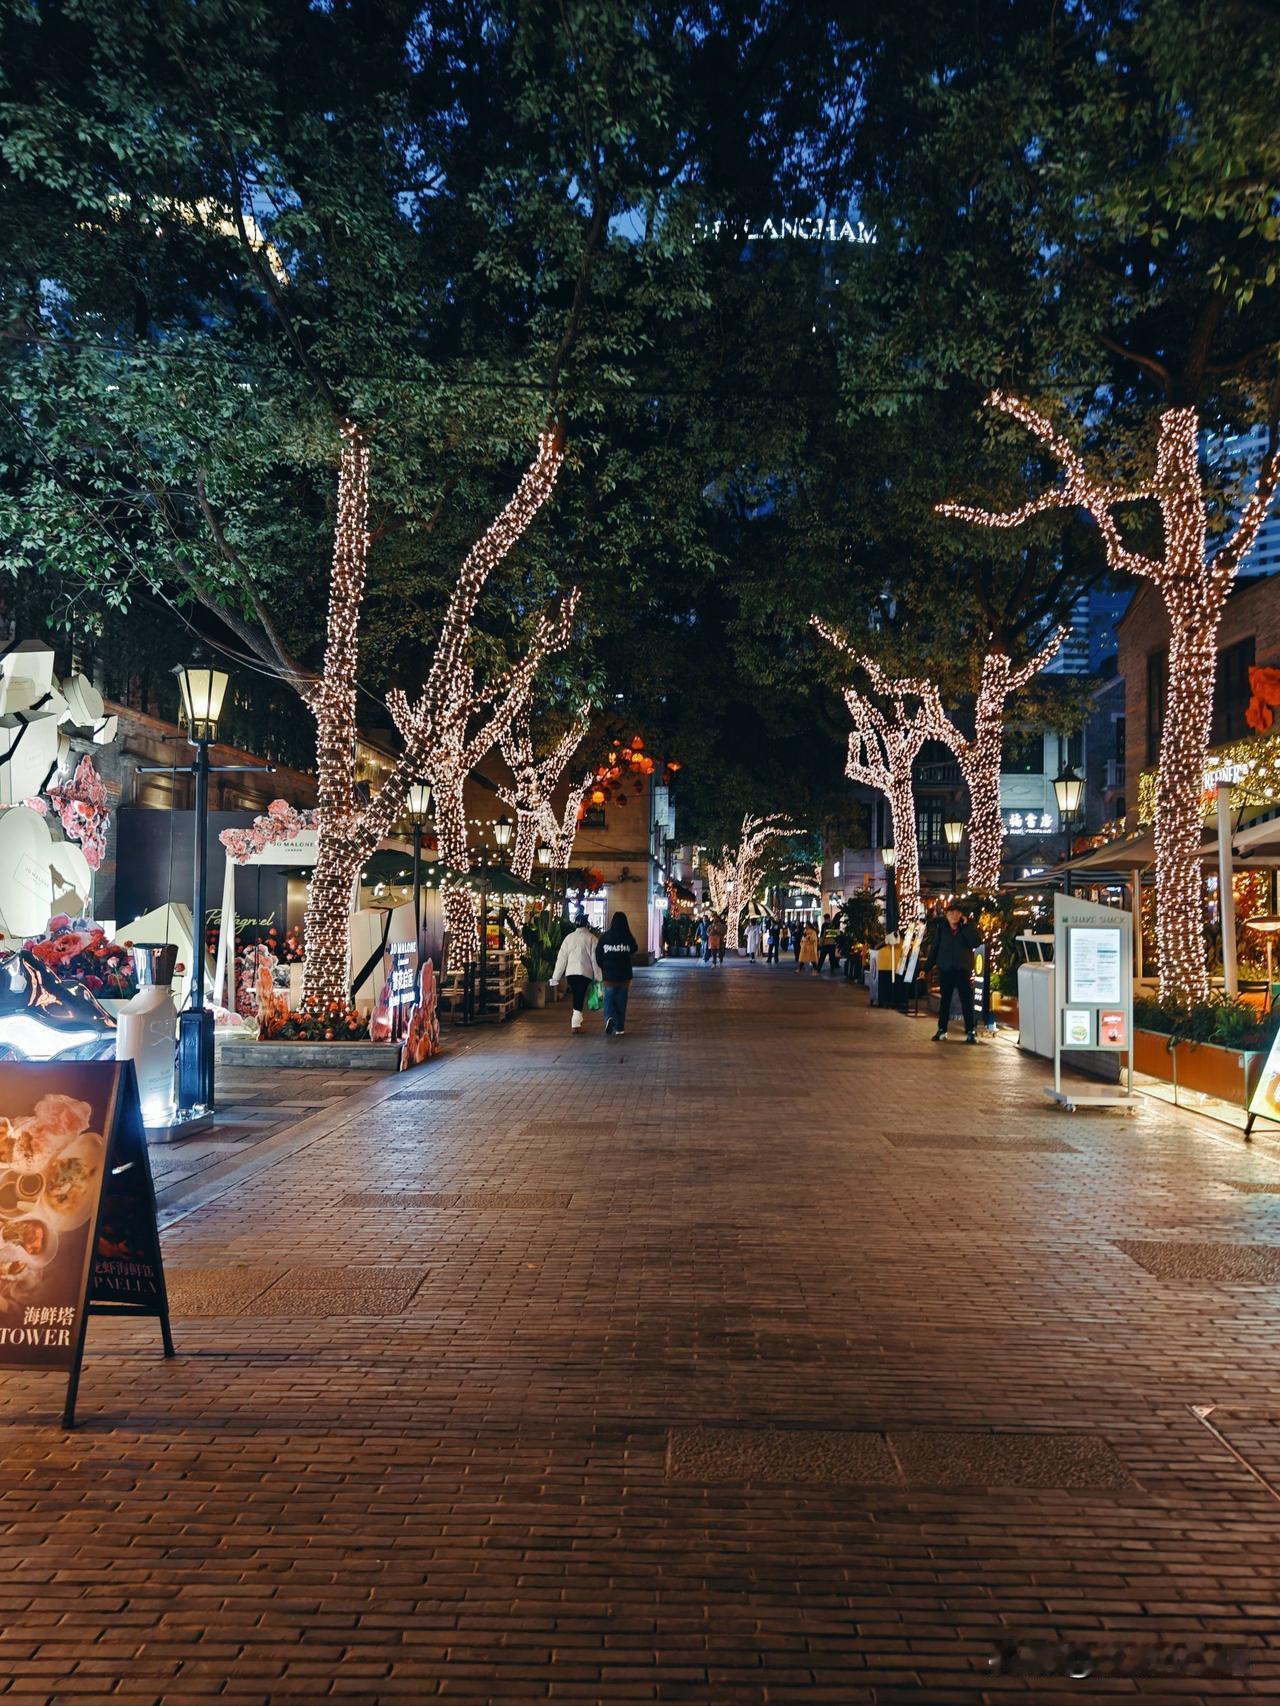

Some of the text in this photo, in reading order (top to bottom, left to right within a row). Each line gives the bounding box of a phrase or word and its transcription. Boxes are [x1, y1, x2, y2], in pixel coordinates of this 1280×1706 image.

[743, 216, 878, 244] LANGHAM
[23, 1306, 76, 1326] 海鲜塔
[0, 1327, 70, 1346] TOWER
